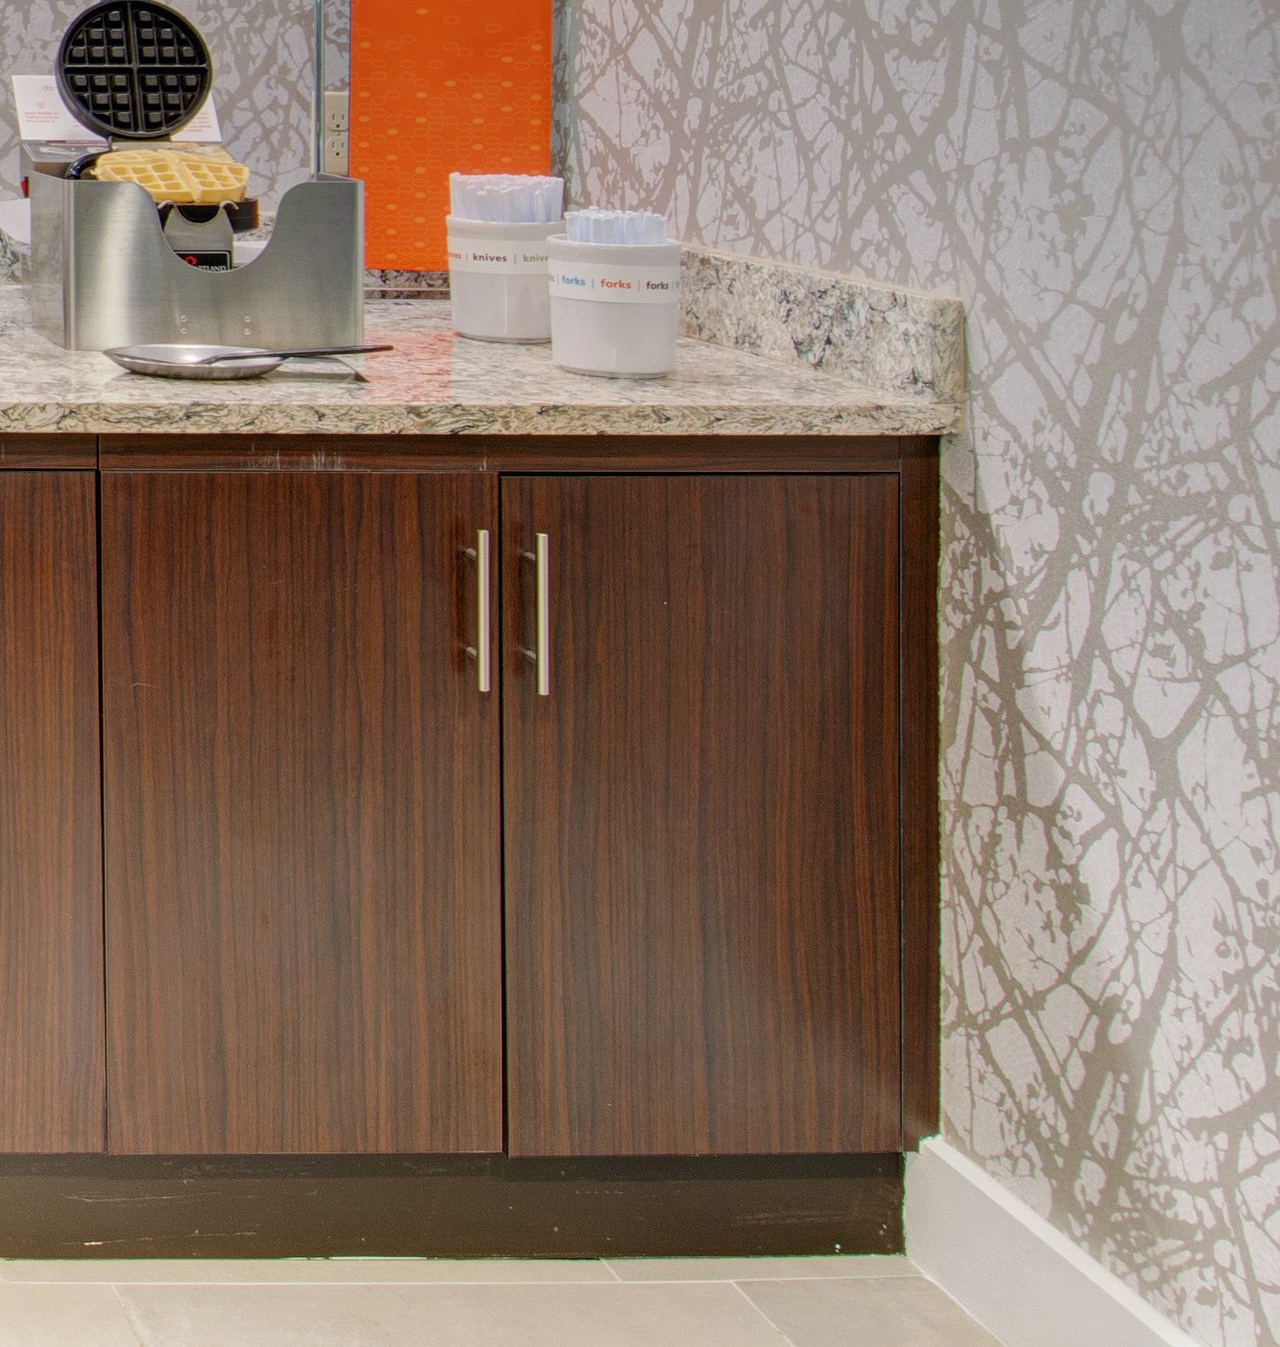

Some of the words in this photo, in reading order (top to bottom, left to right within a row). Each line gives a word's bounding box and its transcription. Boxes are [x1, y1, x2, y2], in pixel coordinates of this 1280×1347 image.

[473, 253, 508, 262] knives
[562, 275, 586, 286] forks
[600, 278, 632, 289] forks
[646, 280, 669, 290] forks
